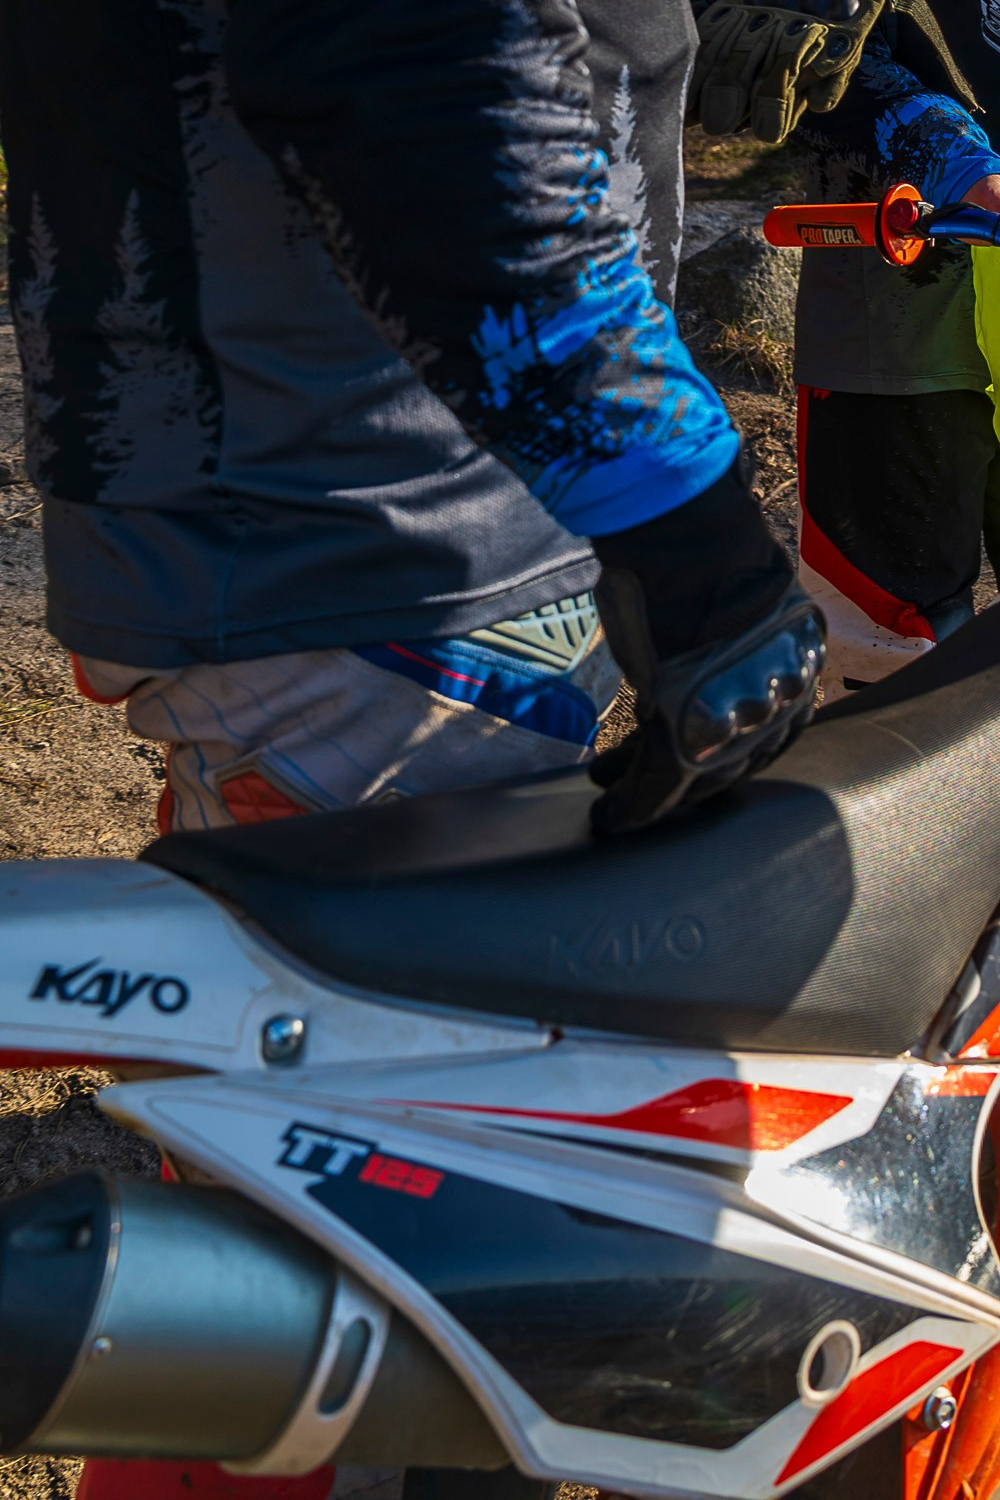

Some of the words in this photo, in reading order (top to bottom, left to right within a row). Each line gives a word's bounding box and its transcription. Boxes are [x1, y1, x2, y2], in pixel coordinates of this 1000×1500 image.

[800, 227, 857, 245] PROTAPER
[285, 1127, 372, 1177] TT
[358, 1152, 445, 1201] 125
